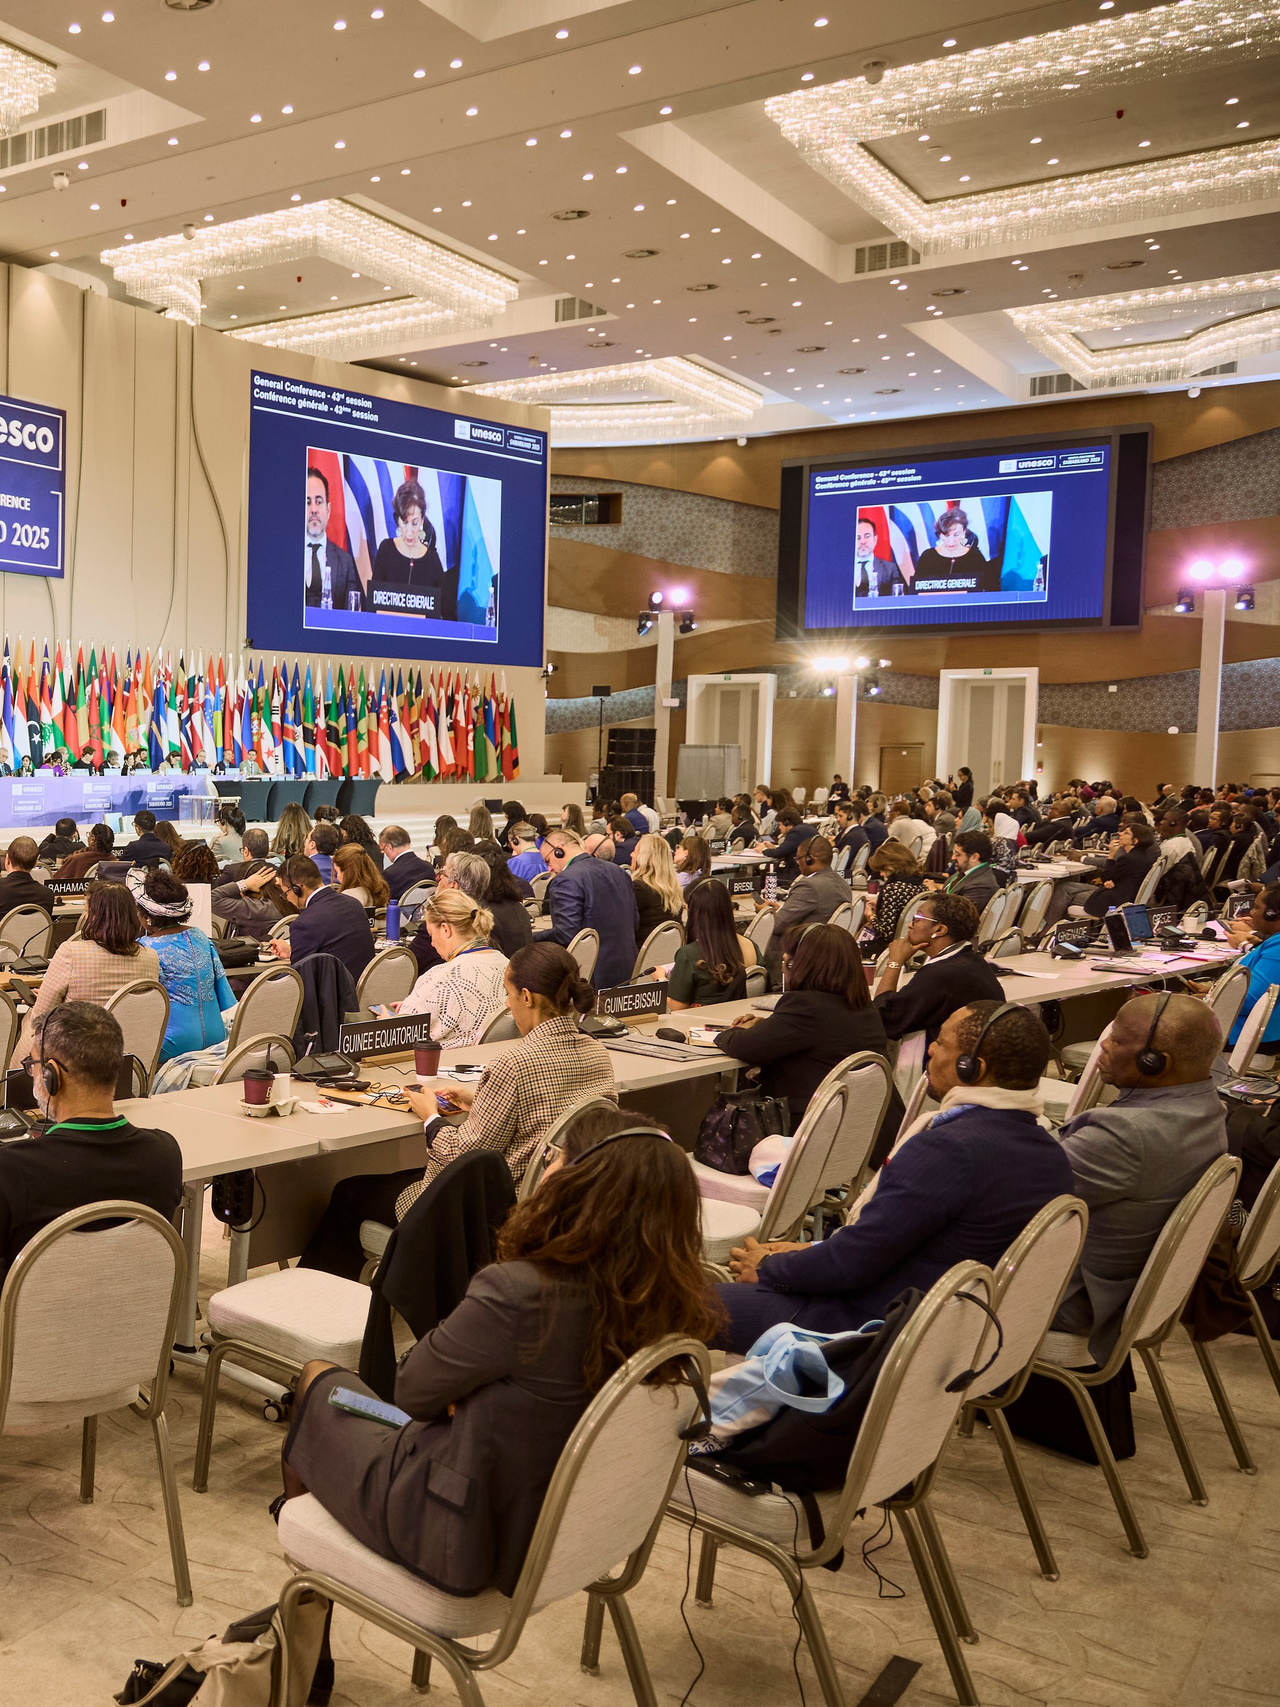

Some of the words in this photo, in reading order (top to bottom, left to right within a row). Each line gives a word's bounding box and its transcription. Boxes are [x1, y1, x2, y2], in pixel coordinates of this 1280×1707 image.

[253, 375, 284, 390] General
[284, 381, 326, 399] Conference
[345, 395, 373, 409] session
[253, 388, 297, 406] Conférence
[297, 397, 329, 412] générale
[352, 408, 379, 423] session
[471, 427, 502, 442] unesco
[1018, 459, 1053, 469] unesco
[11, 522, 50, 550] 2025
[373, 590, 406, 607] DIRECTRICE
[406, 593, 435, 610] GENERALE
[47, 881, 90, 893] BAHAMAS
[733, 881, 755, 892] BRESIL
[604, 990, 662, 1014] GUINEE-BISSAU
[342, 1031, 374, 1054] GUINEE
[374, 1023, 428, 1049] EQUATORIALE
